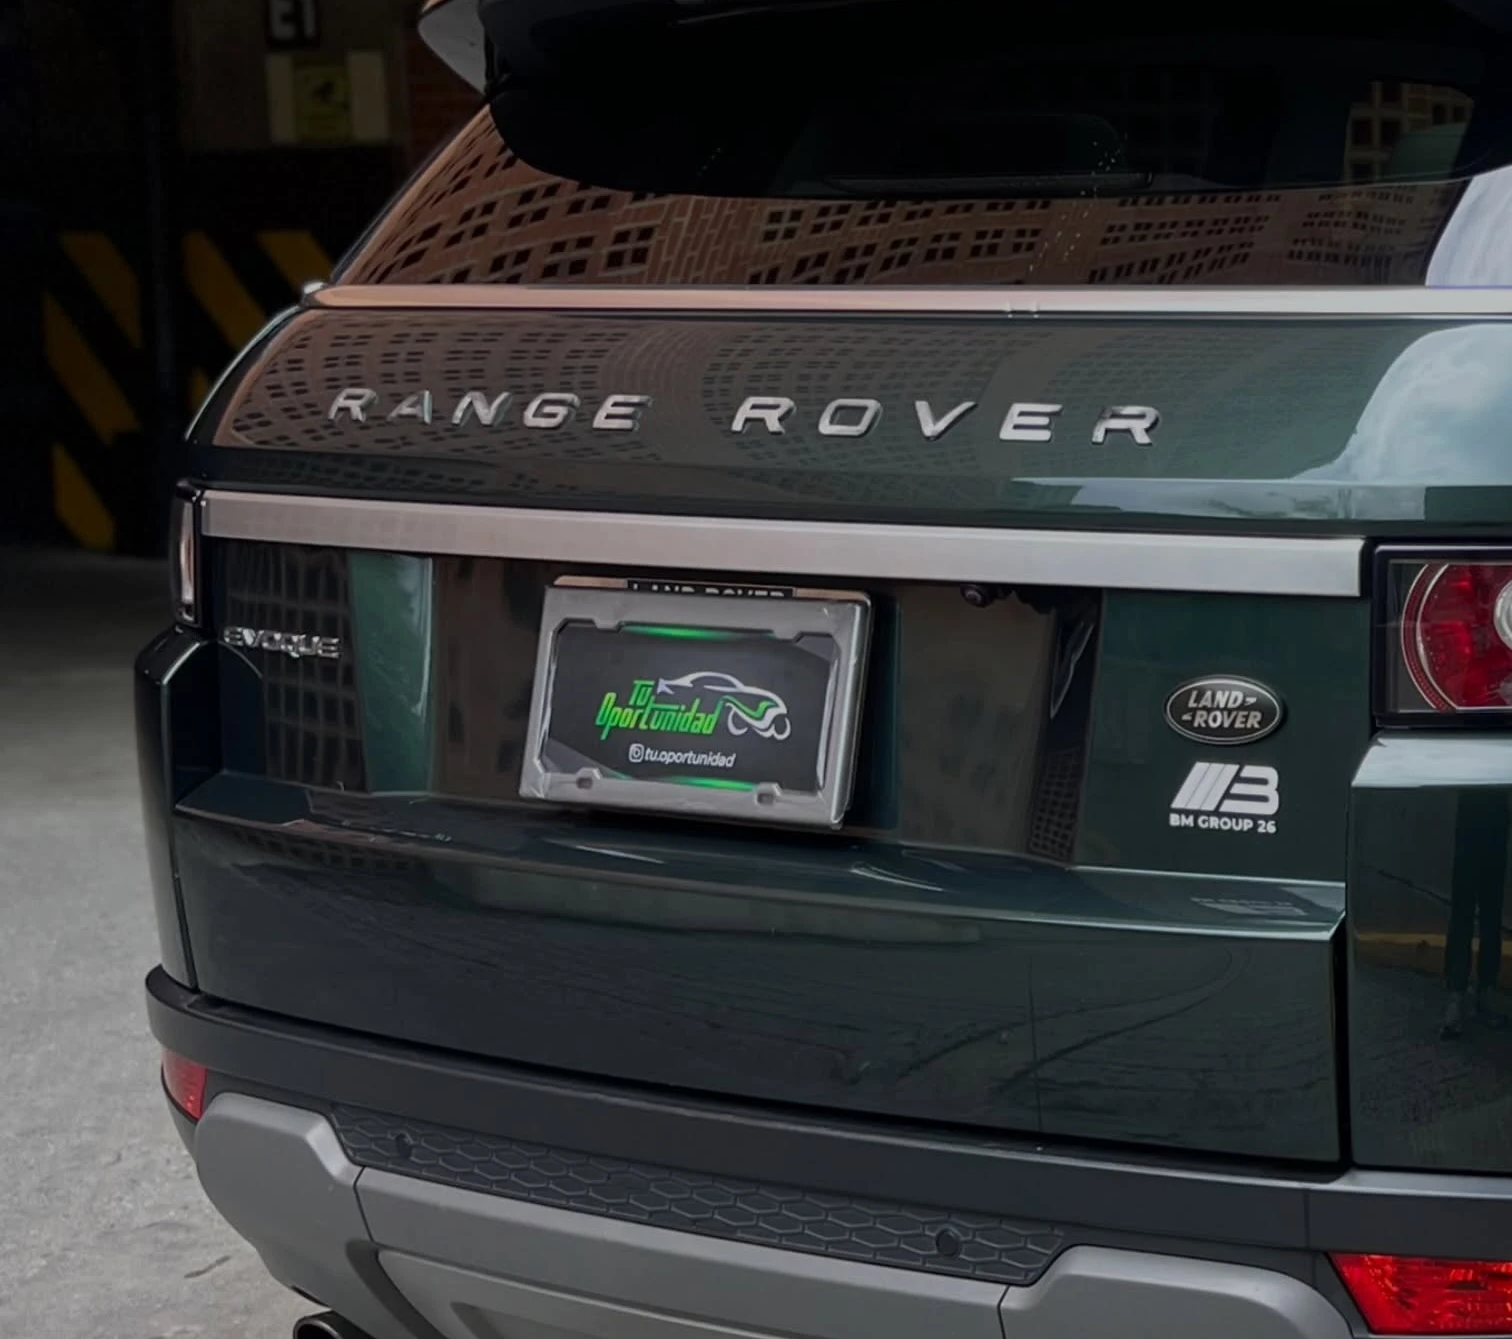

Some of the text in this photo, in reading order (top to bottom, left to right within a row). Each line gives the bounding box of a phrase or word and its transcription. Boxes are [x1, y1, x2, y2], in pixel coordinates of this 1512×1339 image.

[328, 387, 1161, 446] RANGE ROVER
[1187, 689, 1244, 708] LAND
[595, 691, 723, 740] Oportunidad
[1193, 710, 1262, 729] ROVER
[645, 747, 736, 768] tu.oportunidad
[1169, 813, 1276, 833] BM GROUP 26
